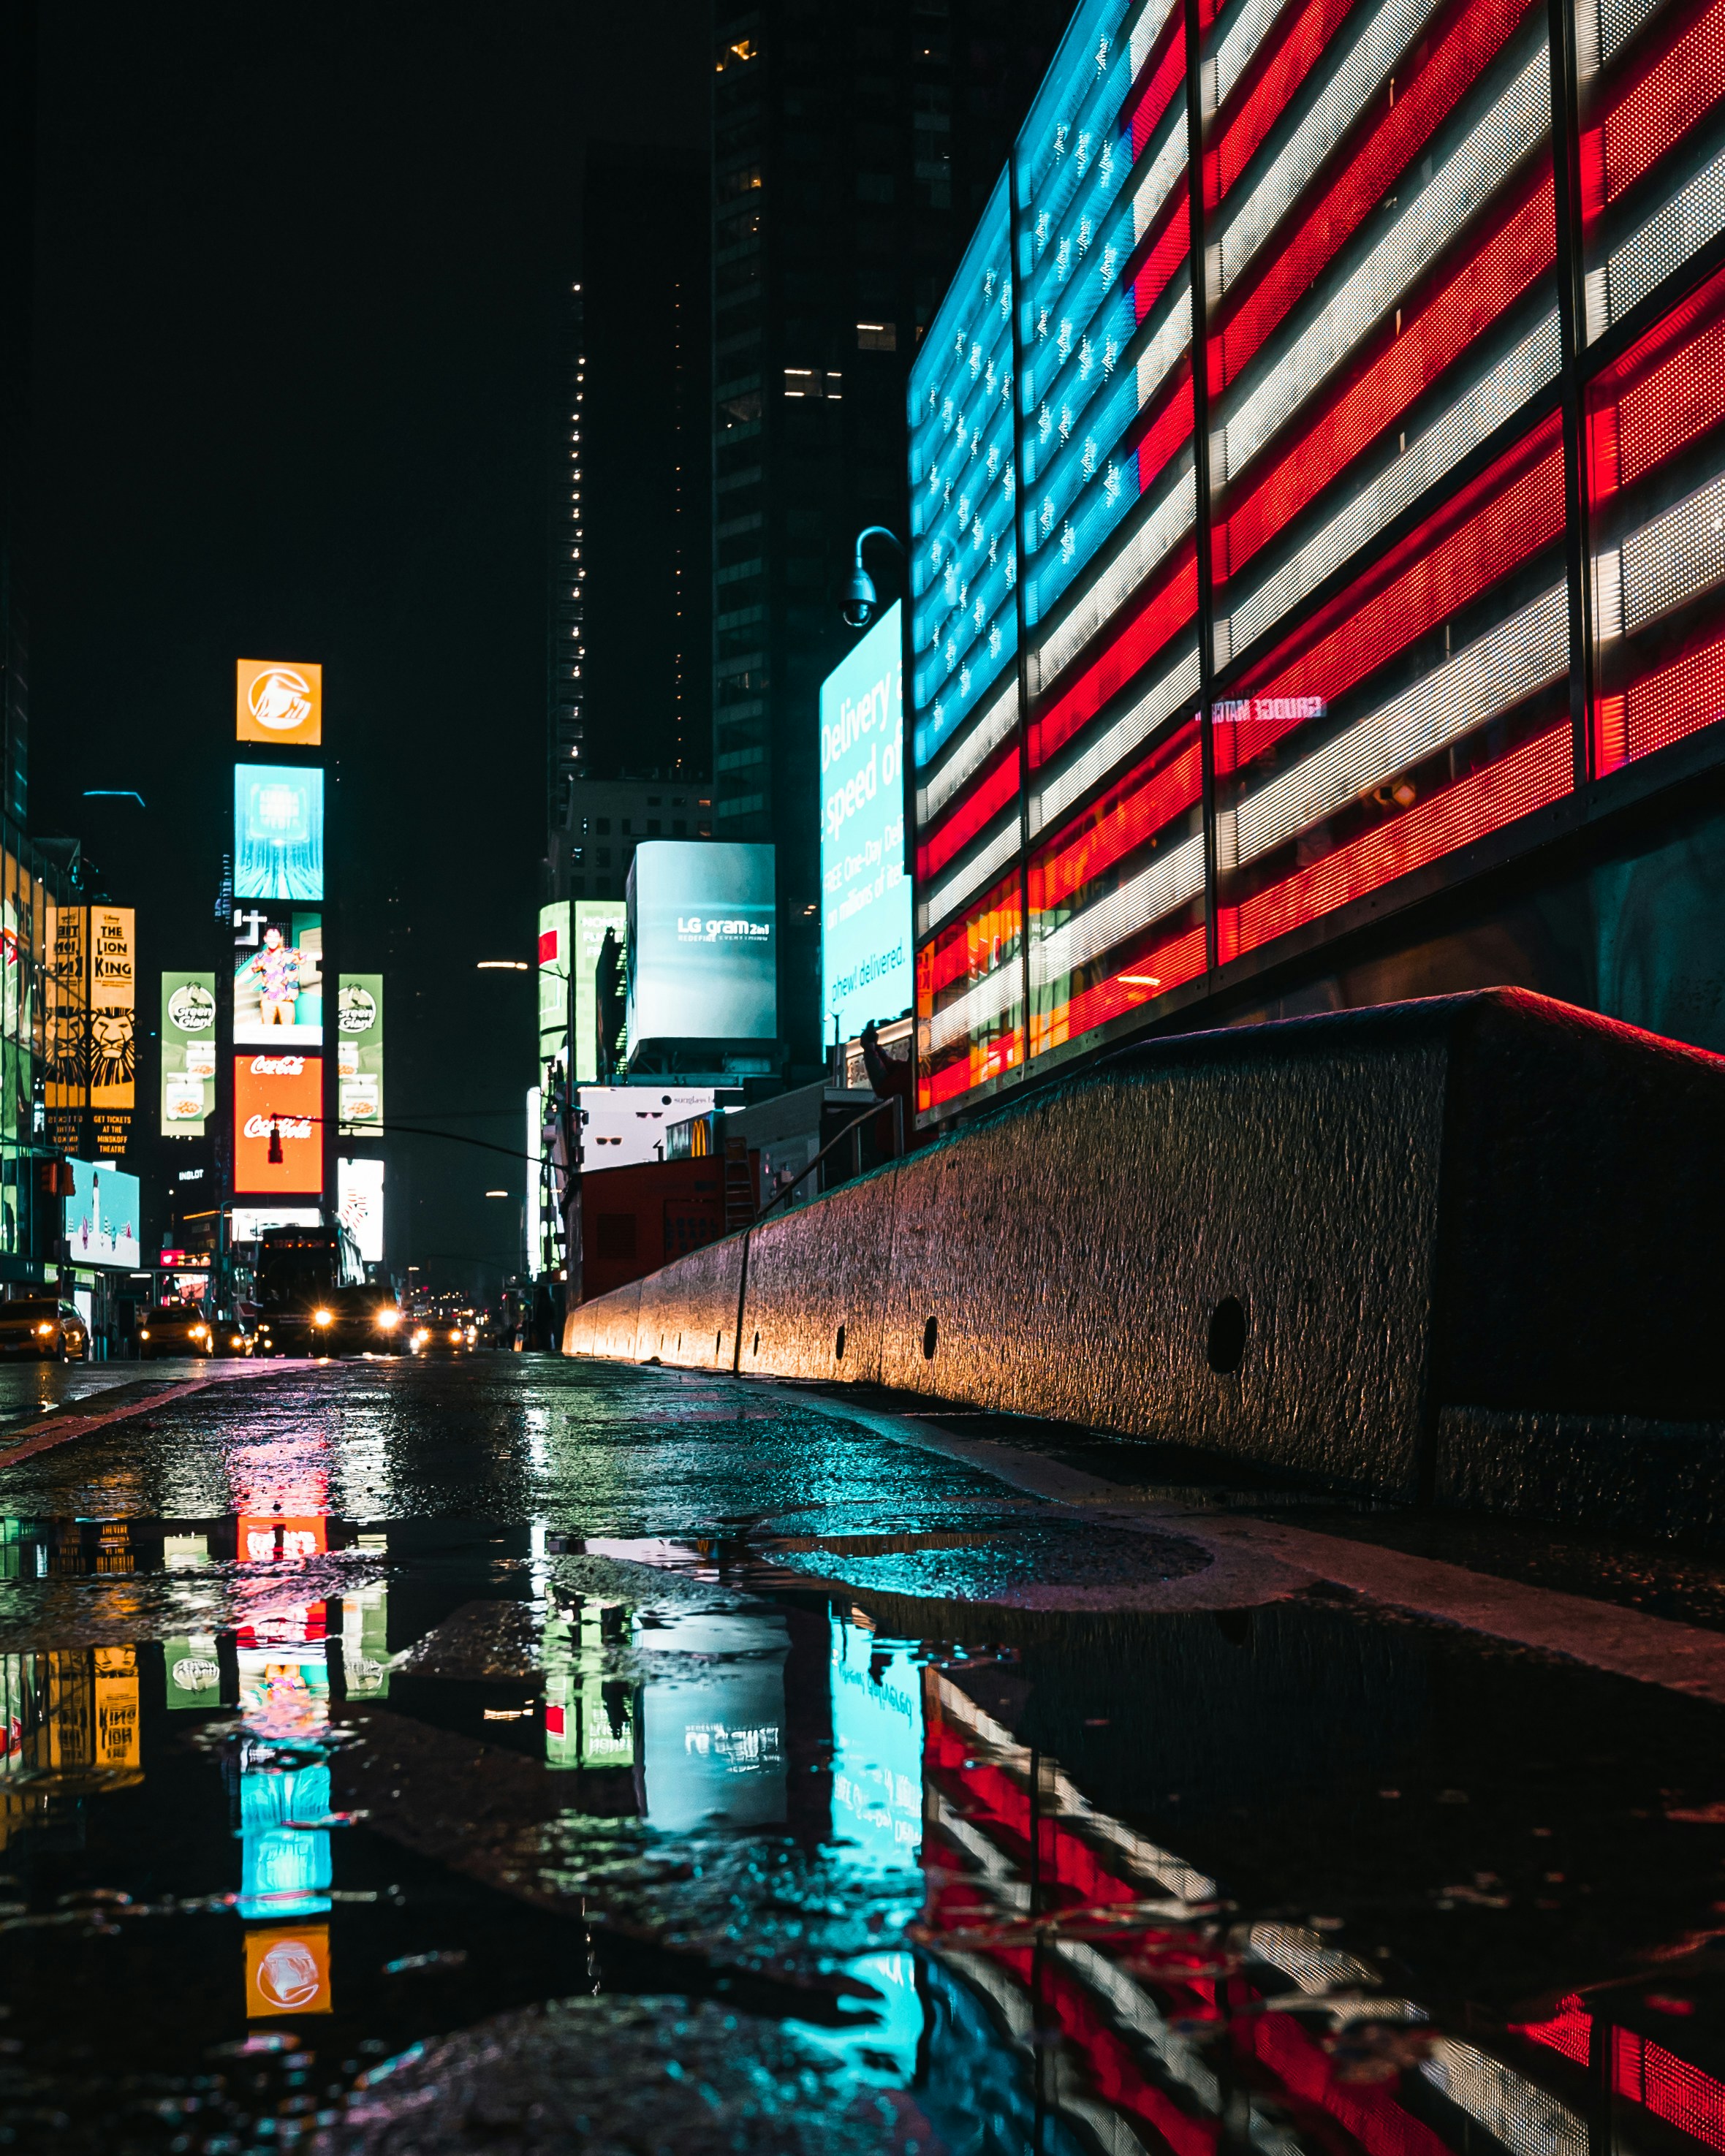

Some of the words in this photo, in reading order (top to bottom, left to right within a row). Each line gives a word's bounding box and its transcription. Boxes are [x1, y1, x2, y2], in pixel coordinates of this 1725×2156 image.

[822, 672, 891, 773] Delivery
[827, 743, 876, 841] speed
[882, 717, 903, 786] of
[844, 838, 882, 881] One-Day
[101, 926, 122, 936] THE
[678, 917, 702, 933] LG
[705, 920, 749, 937] gram
[97, 938, 127, 955] LION
[95, 957, 132, 977] KING
[833, 965, 857, 1009] phew!
[860, 937, 906, 986] delivered.
[175, 1006, 213, 1017] Green
[178, 1015, 213, 1028] Giant
[250, 1055, 306, 1075] Coca-Cola
[674, 1096, 707, 1105] sunglass
[93, 1115, 105, 1123] GET
[107, 1115, 132, 1124] TICKETS
[102, 1126, 110, 1134] AT
[111, 1126, 122, 1134] THE
[96, 1135, 128, 1144] MINSKOFF
[99, 1145, 125, 1154] THEATRE
